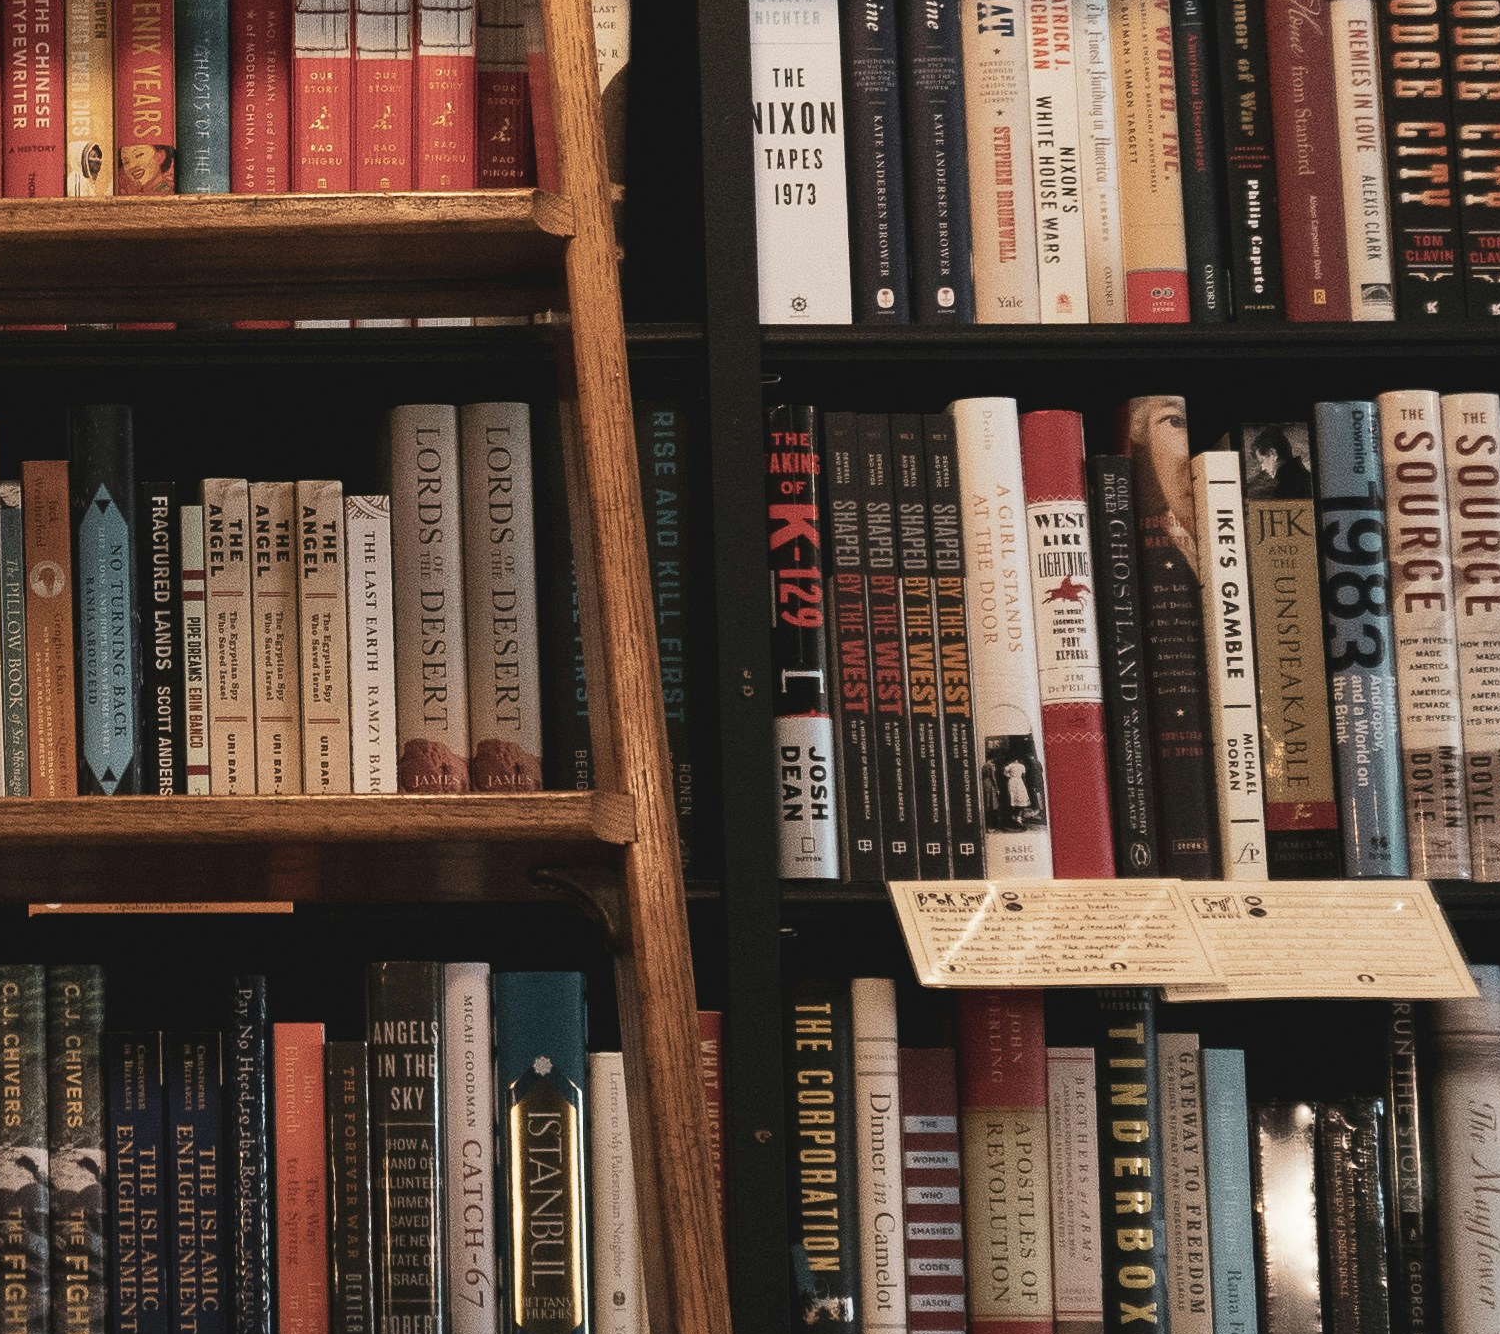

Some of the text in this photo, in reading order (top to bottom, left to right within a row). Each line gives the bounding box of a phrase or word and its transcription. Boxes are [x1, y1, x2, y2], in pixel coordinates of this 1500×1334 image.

[35, 35, 52, 129] CHINESE
[772, 67, 806, 89] THE
[750, 101, 838, 136] NIXON
[763, 148, 824, 171] TAPES
[1396, 122, 1452, 209] CITY
[773, 183, 818, 206] 1973
[1404, 249, 1455, 264] CLAVIN
[1414, 234, 1443, 250] TOM
[1395, 430, 1446, 616] SOURCE
[152, 495, 173, 671] FRACTURED LANDS
[768, 502, 826, 629] K-129
[1325, 480, 1386, 669] 1983
[1215, 509, 1245, 680] IKE'S GAMBLE
[780, 746, 801, 823] DEAN
[807, 746, 829, 821] JOSH
[372, 1020, 440, 1045] ANGELS
[377, 1053, 440, 1077] IN THE
[389, 1087, 424, 1112] SKY
[794, 1002, 842, 1273] THE CORPORATION
[920, 1120, 939, 1129] THE
[910, 1155, 950, 1165] WOMAN
[1107, 1021, 1161, 1328] TINDERBOX
[526, 1112, 564, 1289] ISTANBUL
[920, 1191, 943, 1201] WHO
[462, 1139, 492, 1310] CATCH-67
[908, 1226, 955, 1237] SMASHED
[918, 1262, 950, 1272] CODES
